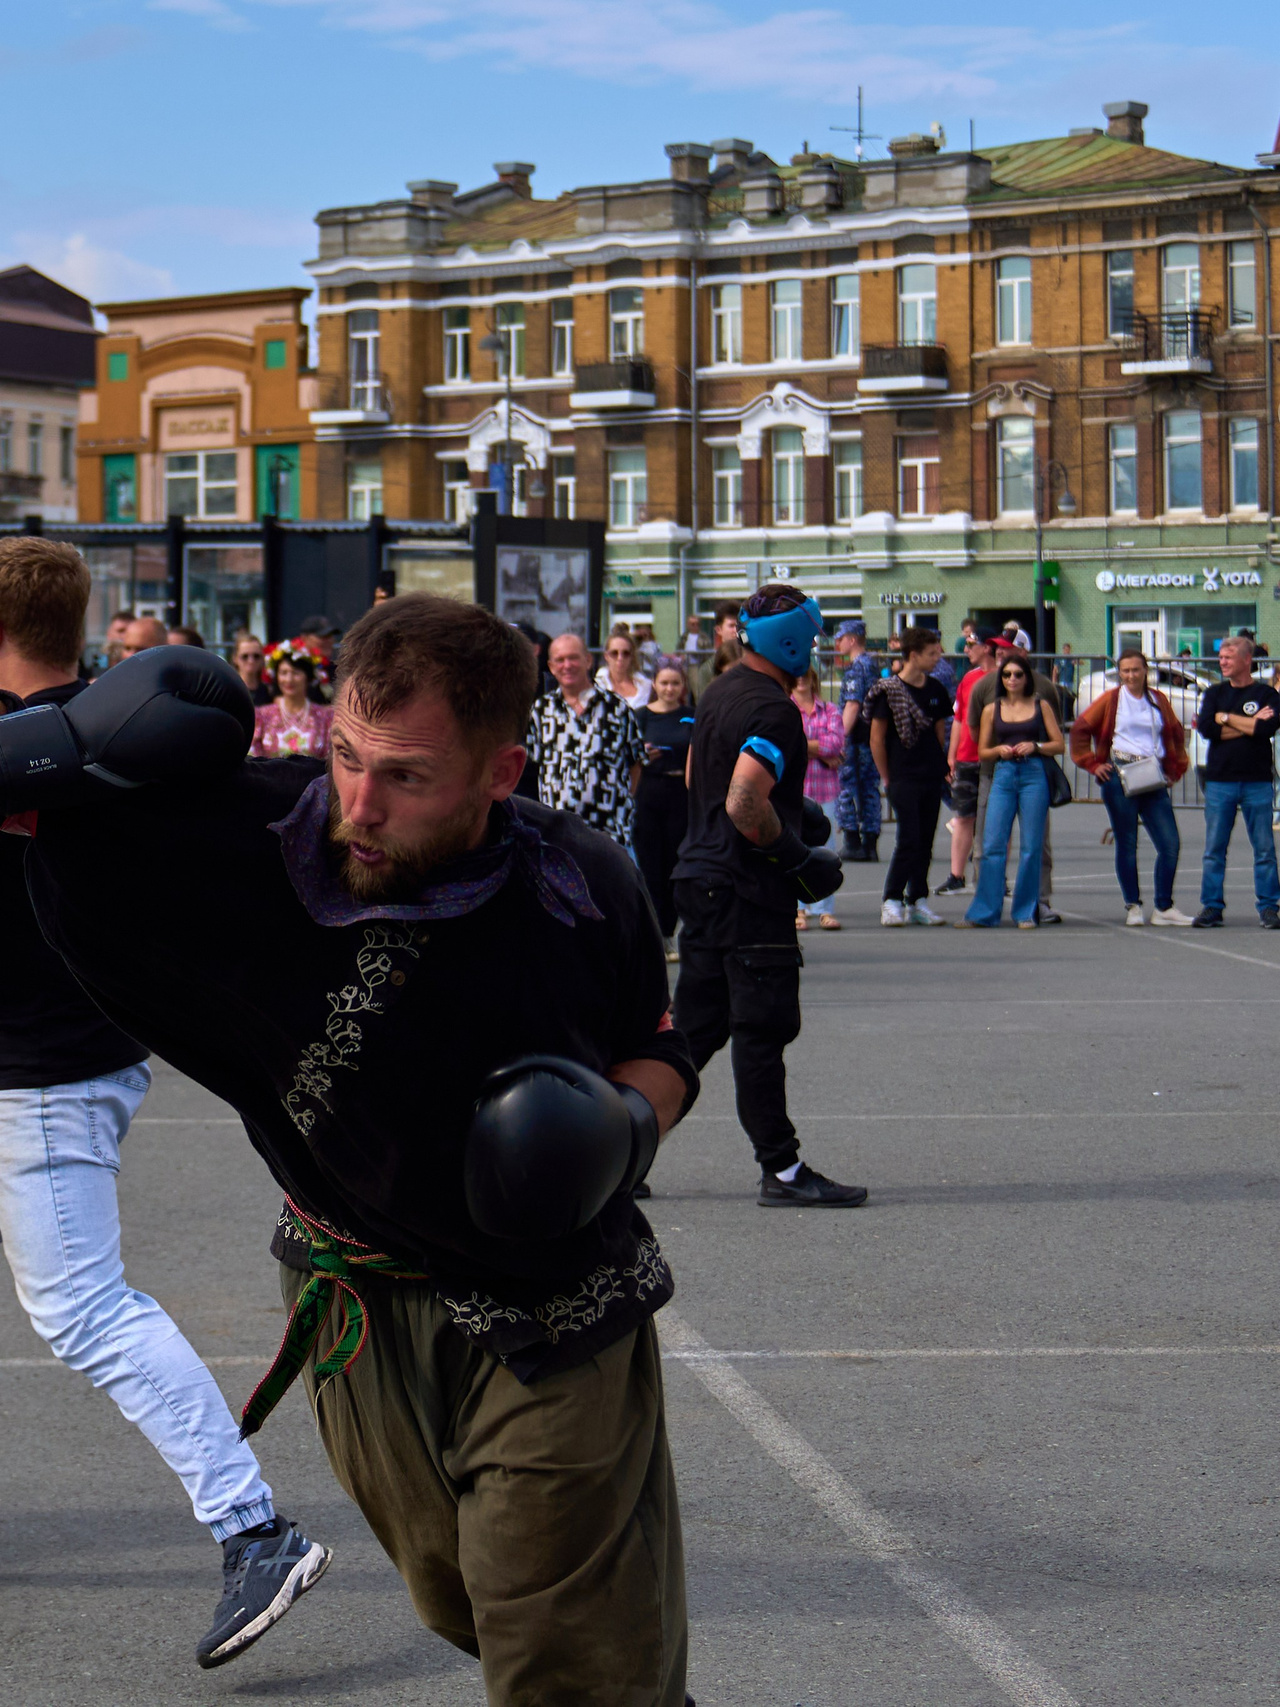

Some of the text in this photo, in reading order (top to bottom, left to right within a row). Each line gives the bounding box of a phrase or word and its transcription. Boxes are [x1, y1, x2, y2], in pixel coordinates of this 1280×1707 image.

[1220, 571, 1262, 586] YOTA
[878, 592, 943, 605] THE LOBBY
[29, 759, 40, 768] 14
